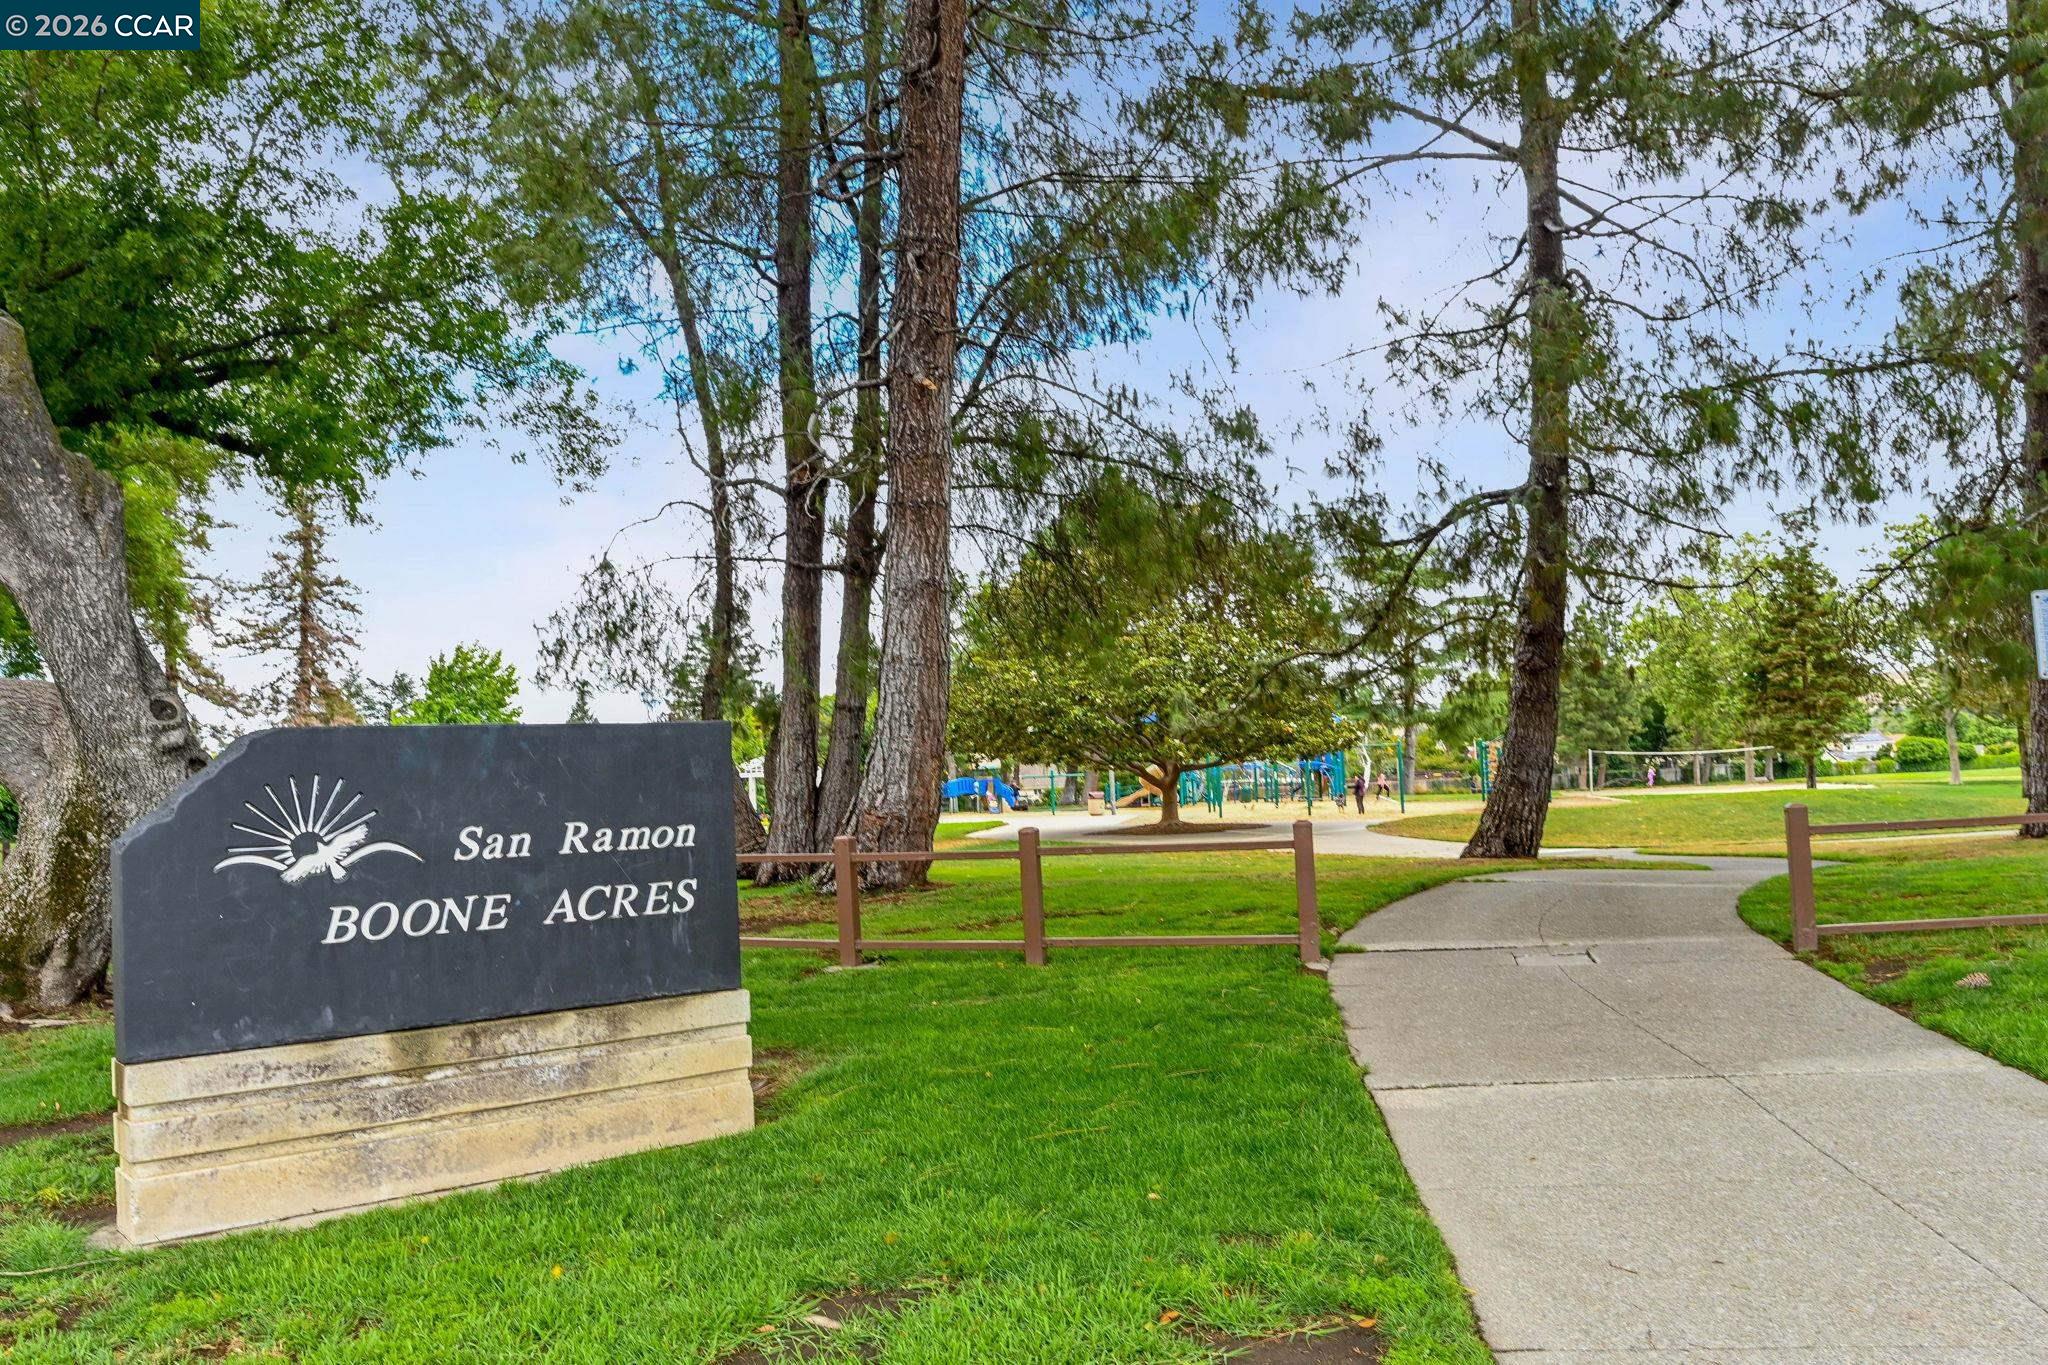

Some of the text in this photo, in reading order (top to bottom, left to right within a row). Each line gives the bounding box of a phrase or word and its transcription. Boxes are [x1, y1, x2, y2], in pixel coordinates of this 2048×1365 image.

[454, 821, 696, 862] San Ramon
[321, 878, 698, 945] BOONE ACRES
